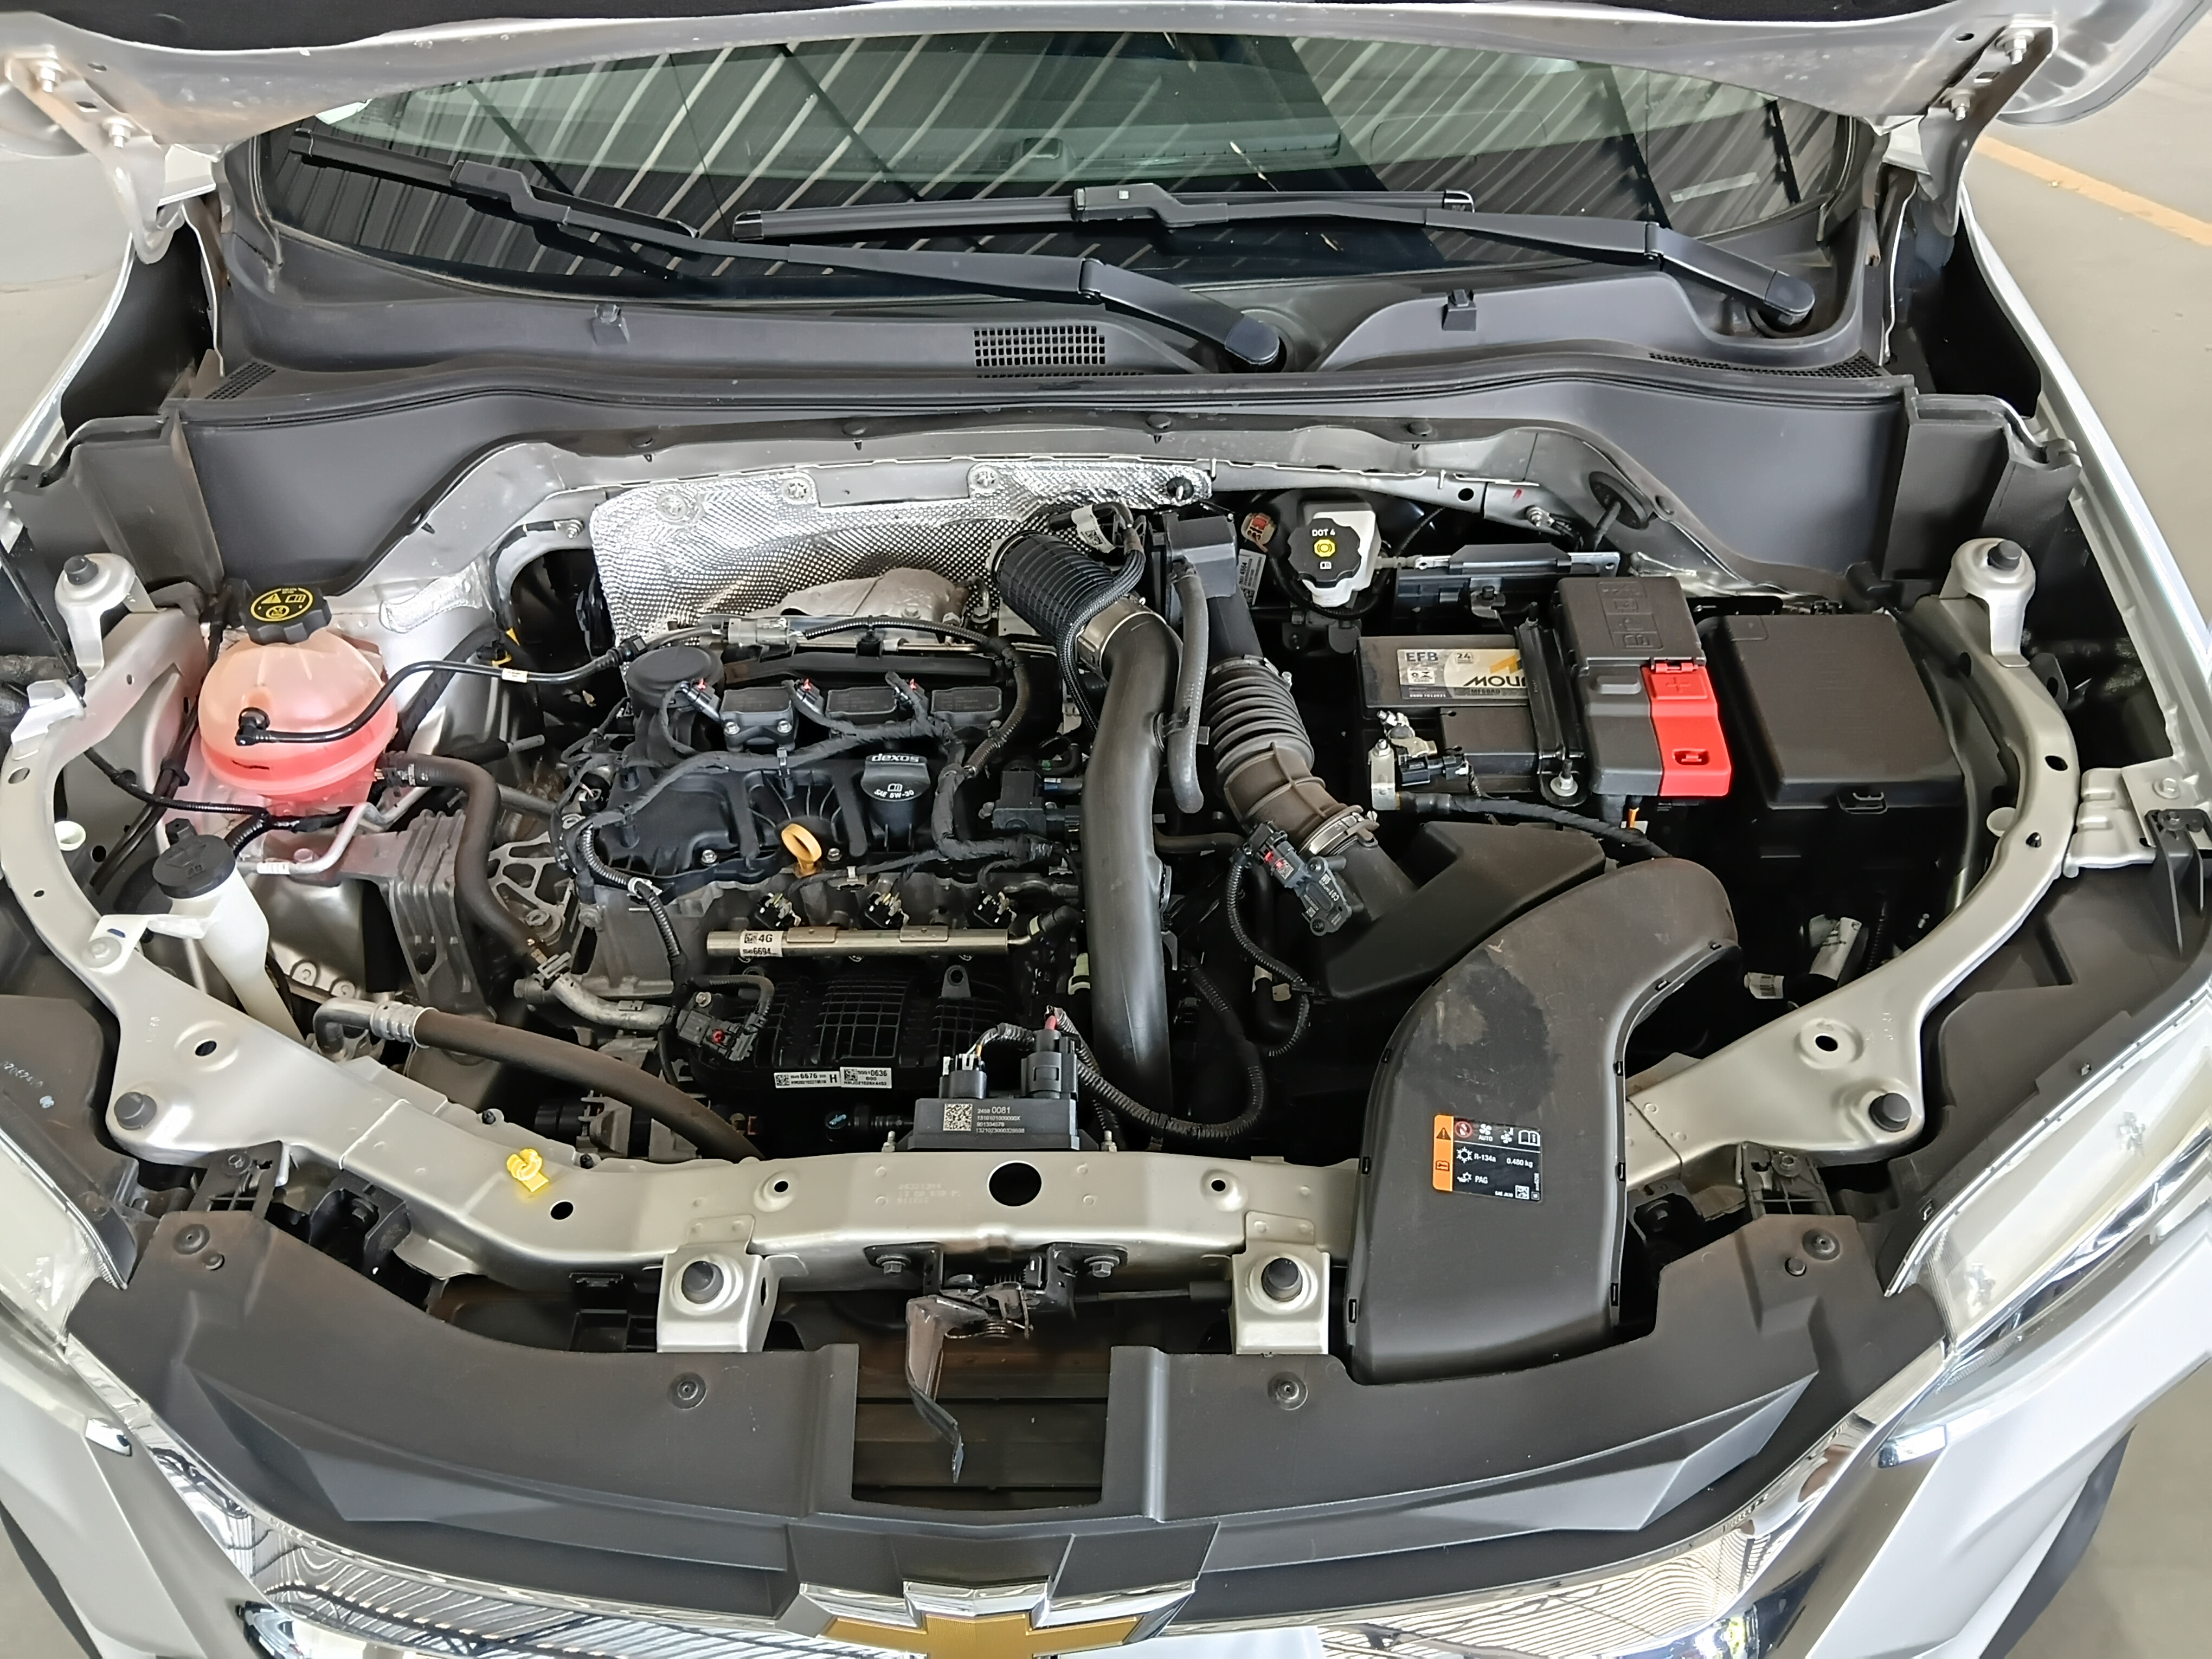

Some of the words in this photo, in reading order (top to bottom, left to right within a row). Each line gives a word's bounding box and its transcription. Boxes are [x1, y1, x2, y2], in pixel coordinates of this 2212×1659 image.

[1406, 652, 1438, 662] EFB
[871, 753, 920, 762] dexos
[874, 789, 888, 798] SAE
[889, 789, 915, 799] 5W-30
[758, 934, 773, 942] 4G
[829, 1074, 837, 1083] H
[991, 1106, 1011, 1114] 0081
[1474, 1153, 1496, 1162] R-134a
[1525, 1160, 1533, 1168] kg
[1475, 1175, 1488, 1184] PAG
